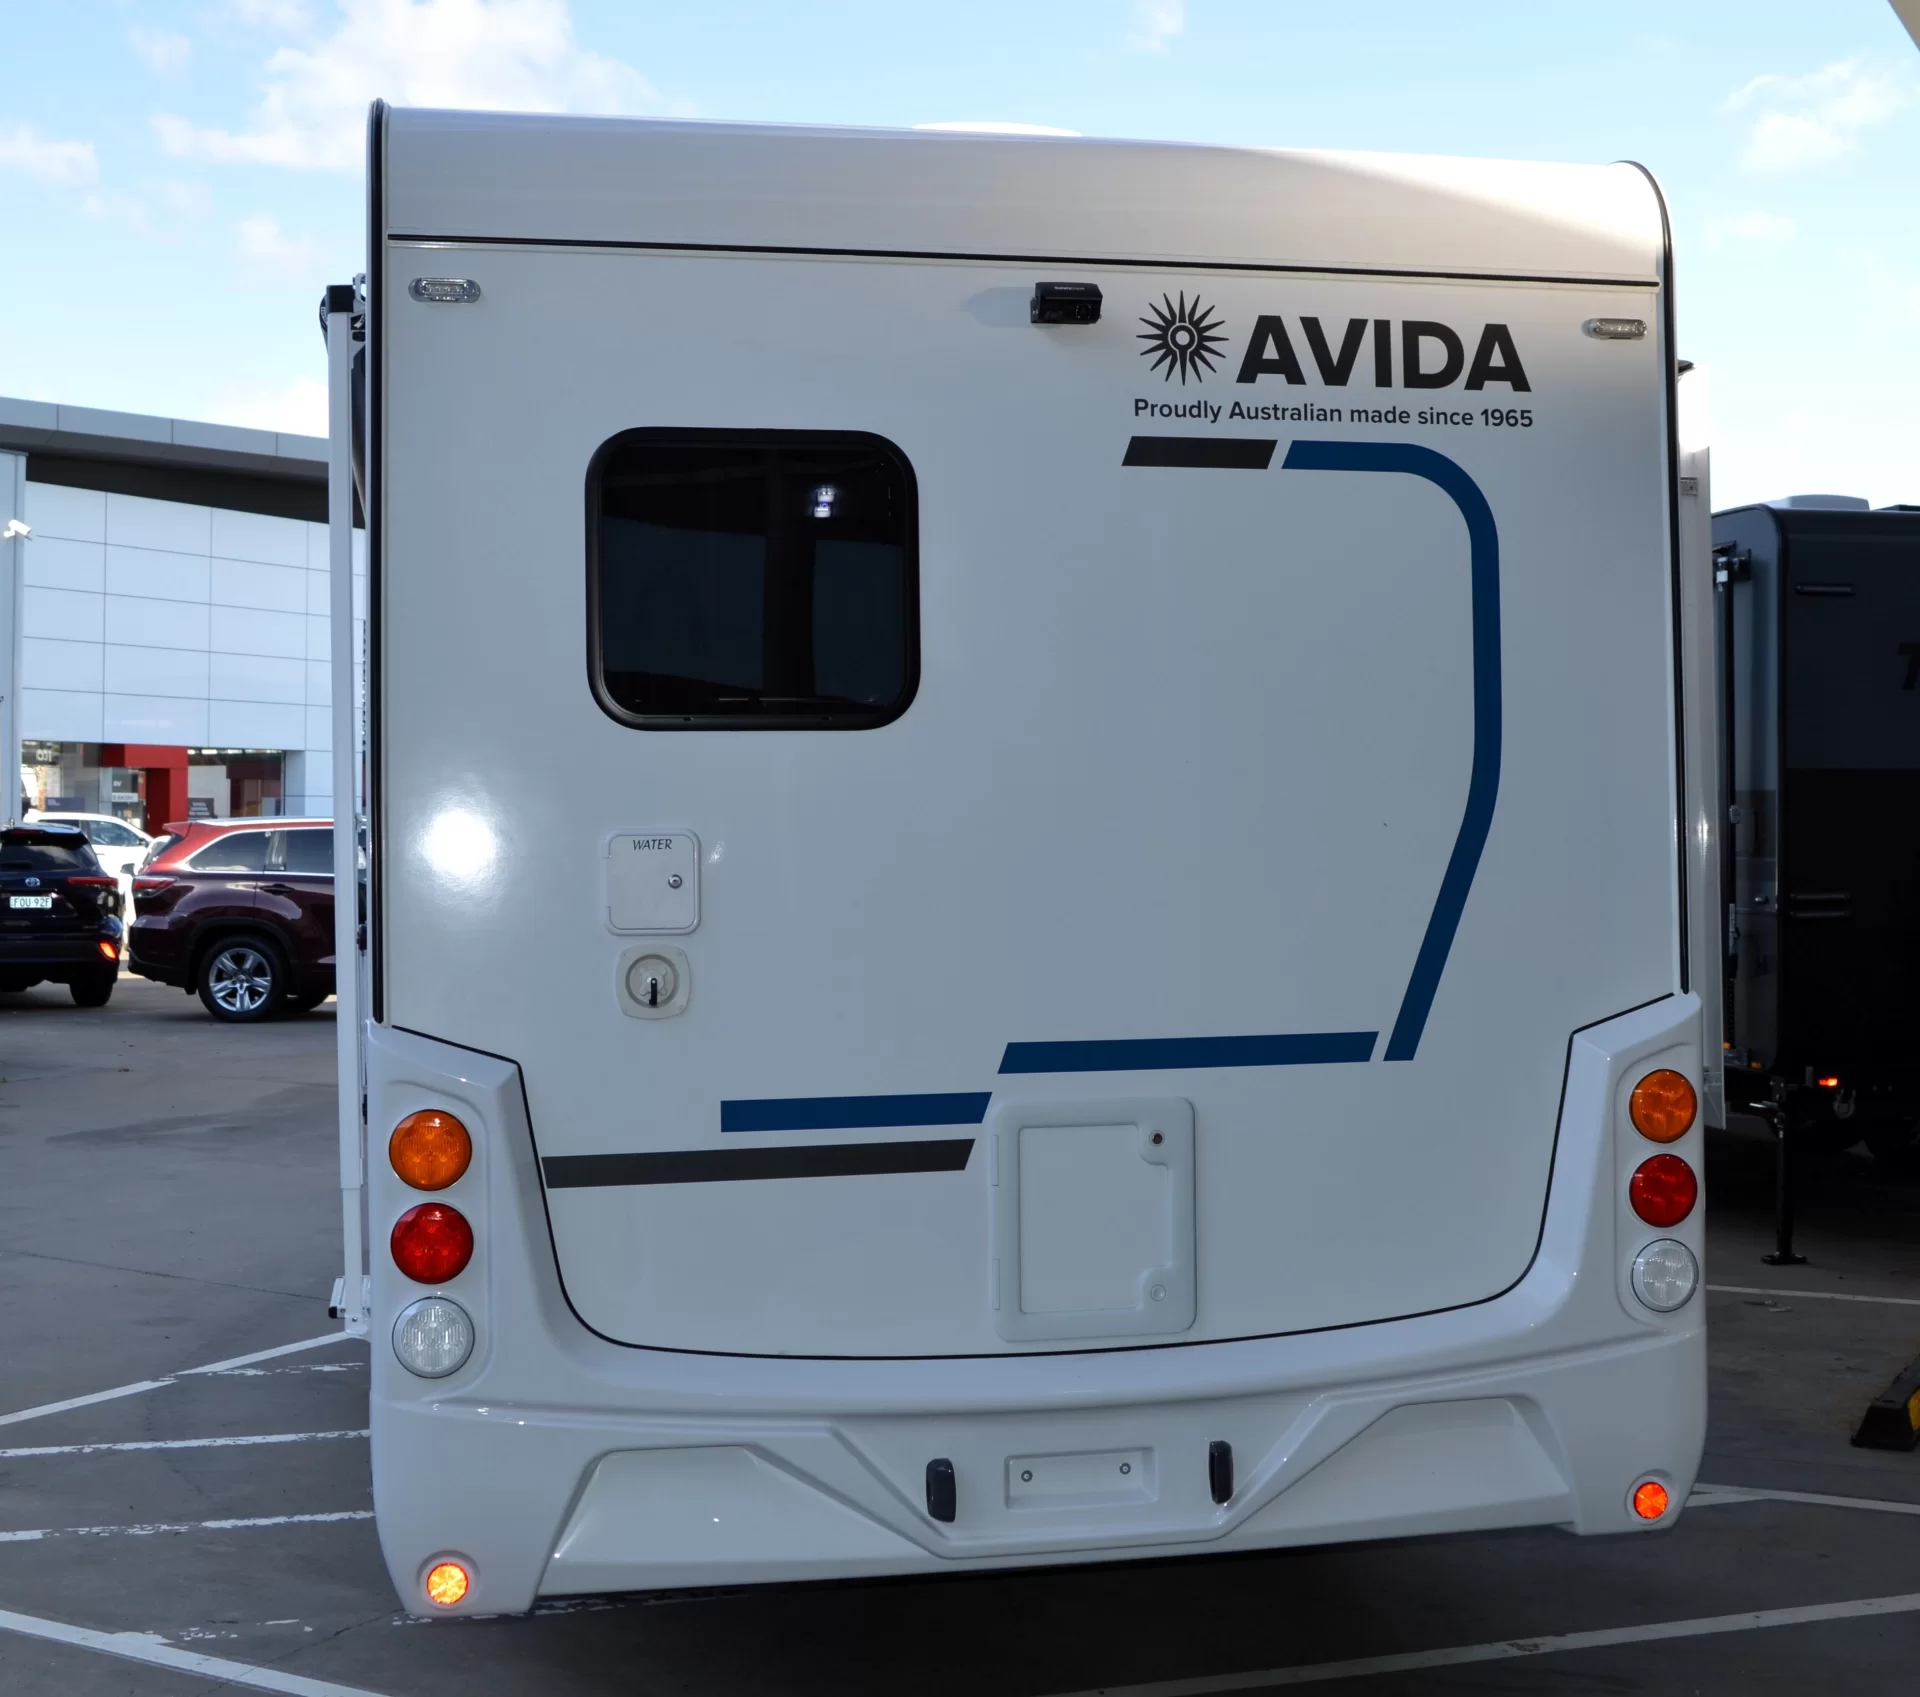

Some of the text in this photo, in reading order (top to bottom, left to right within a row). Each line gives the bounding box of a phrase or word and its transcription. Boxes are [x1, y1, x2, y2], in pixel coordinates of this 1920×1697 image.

[1235, 313, 1532, 393] AVIDA
[1133, 398, 1534, 428] Proudly Australian made since 1965
[632, 838, 673, 851] WATER
